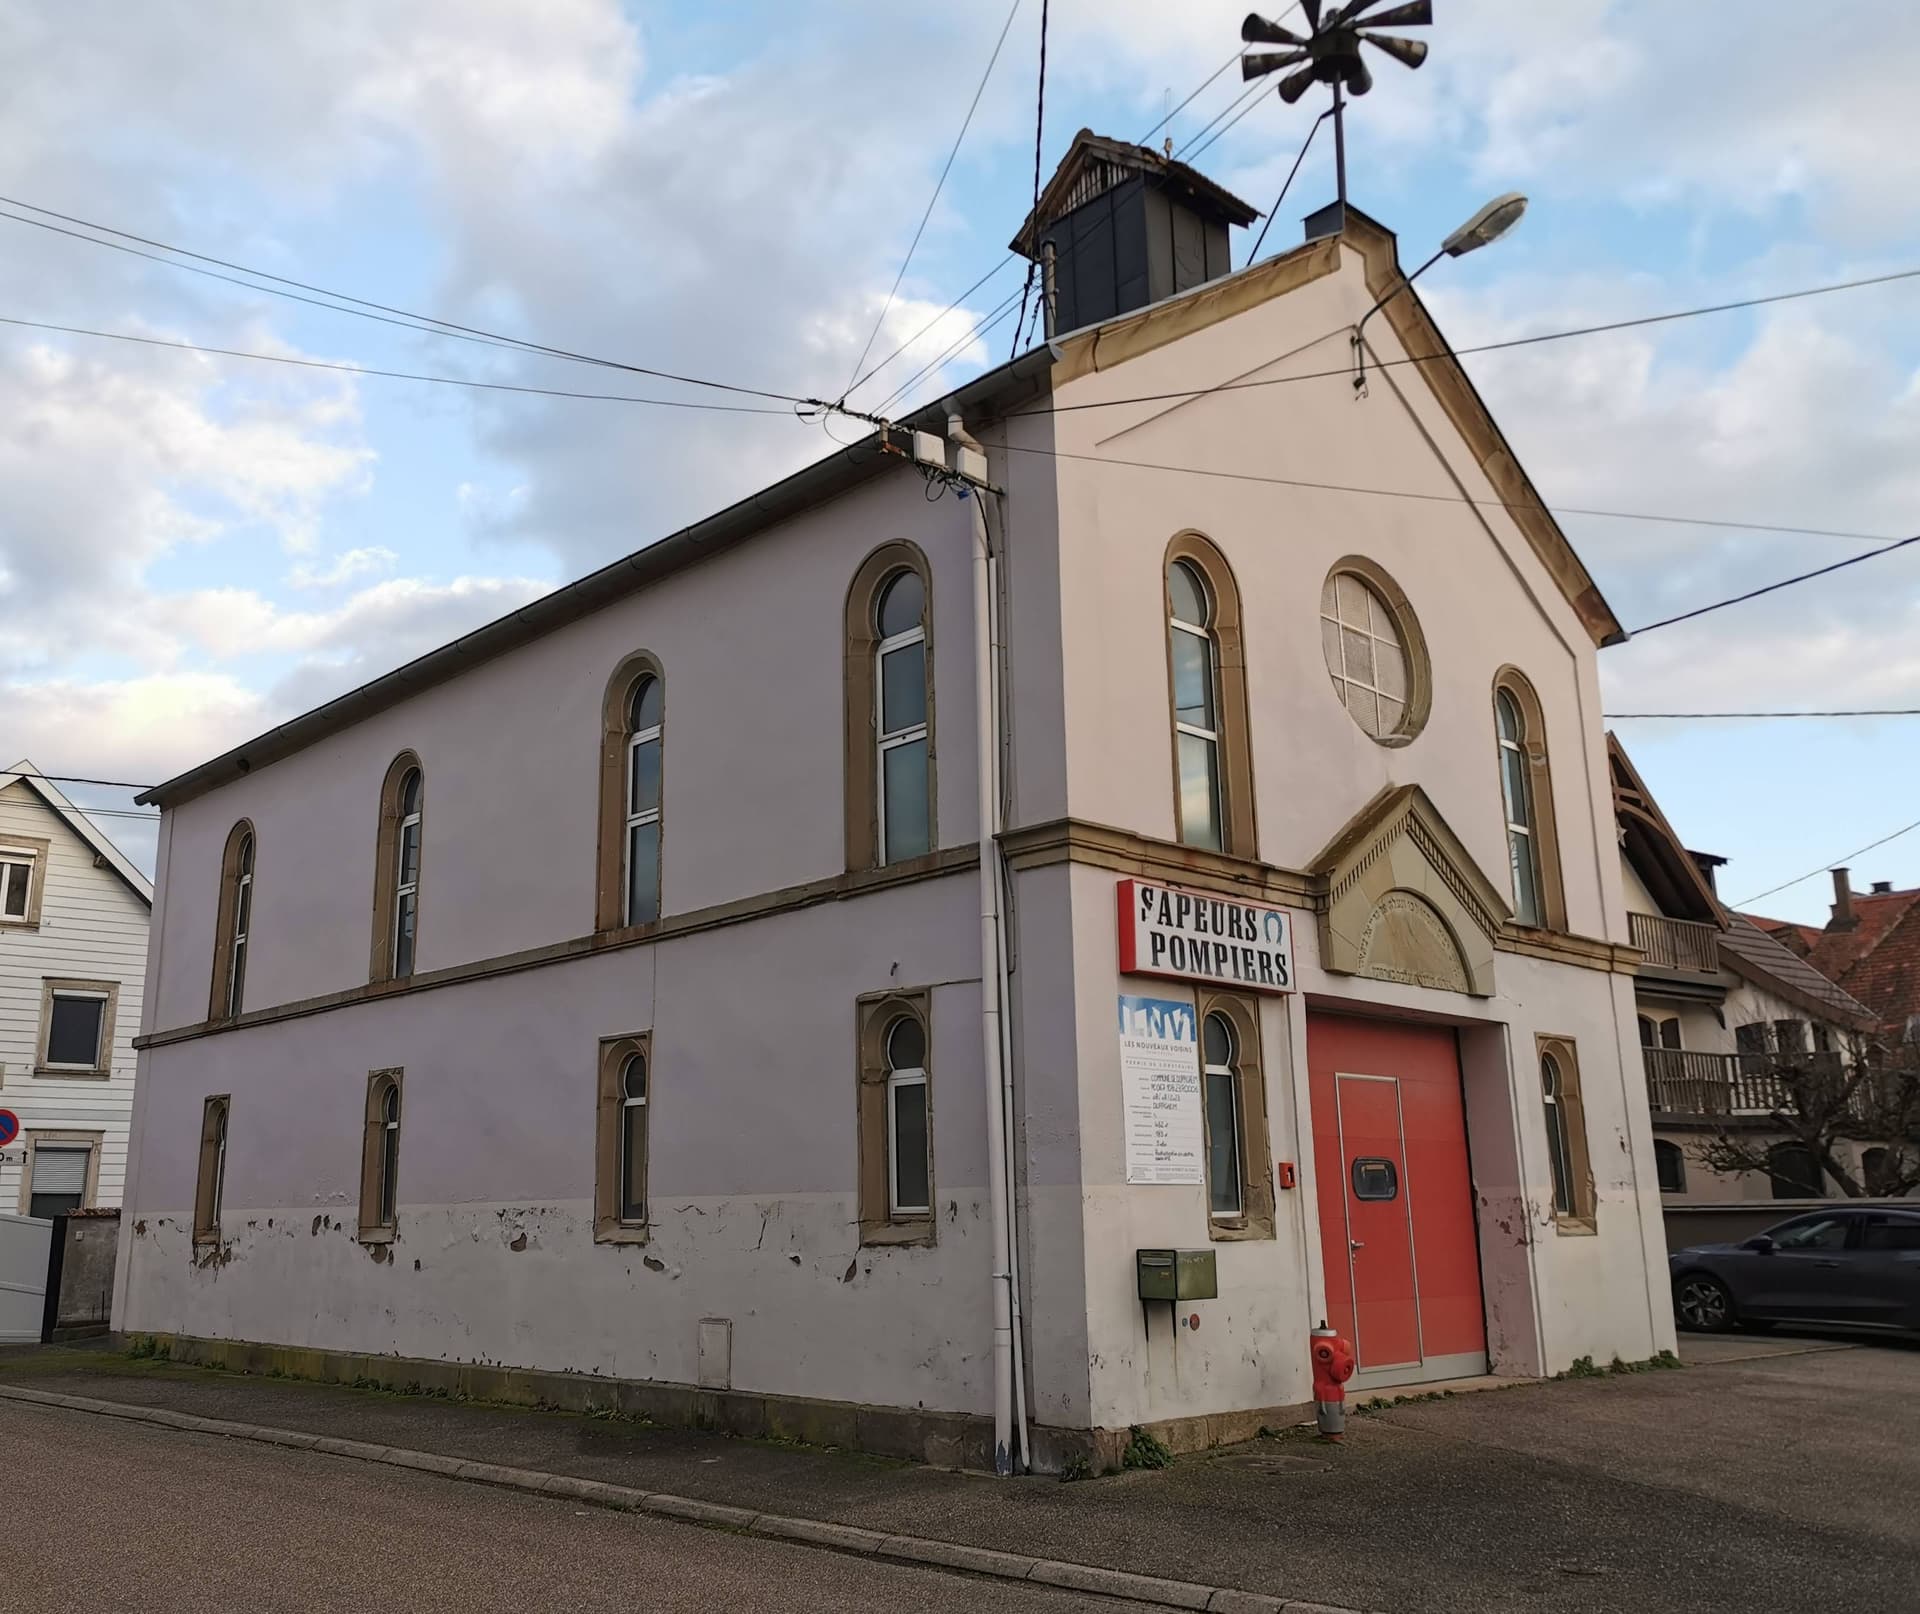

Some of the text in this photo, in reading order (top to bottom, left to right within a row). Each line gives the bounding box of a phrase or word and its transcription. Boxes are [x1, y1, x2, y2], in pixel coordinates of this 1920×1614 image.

[1141, 887, 1258, 942] SAPEURS
[1150, 931, 1289, 986] POMPIERS
[1136, 1042, 1169, 1051] NOUVEAUX
